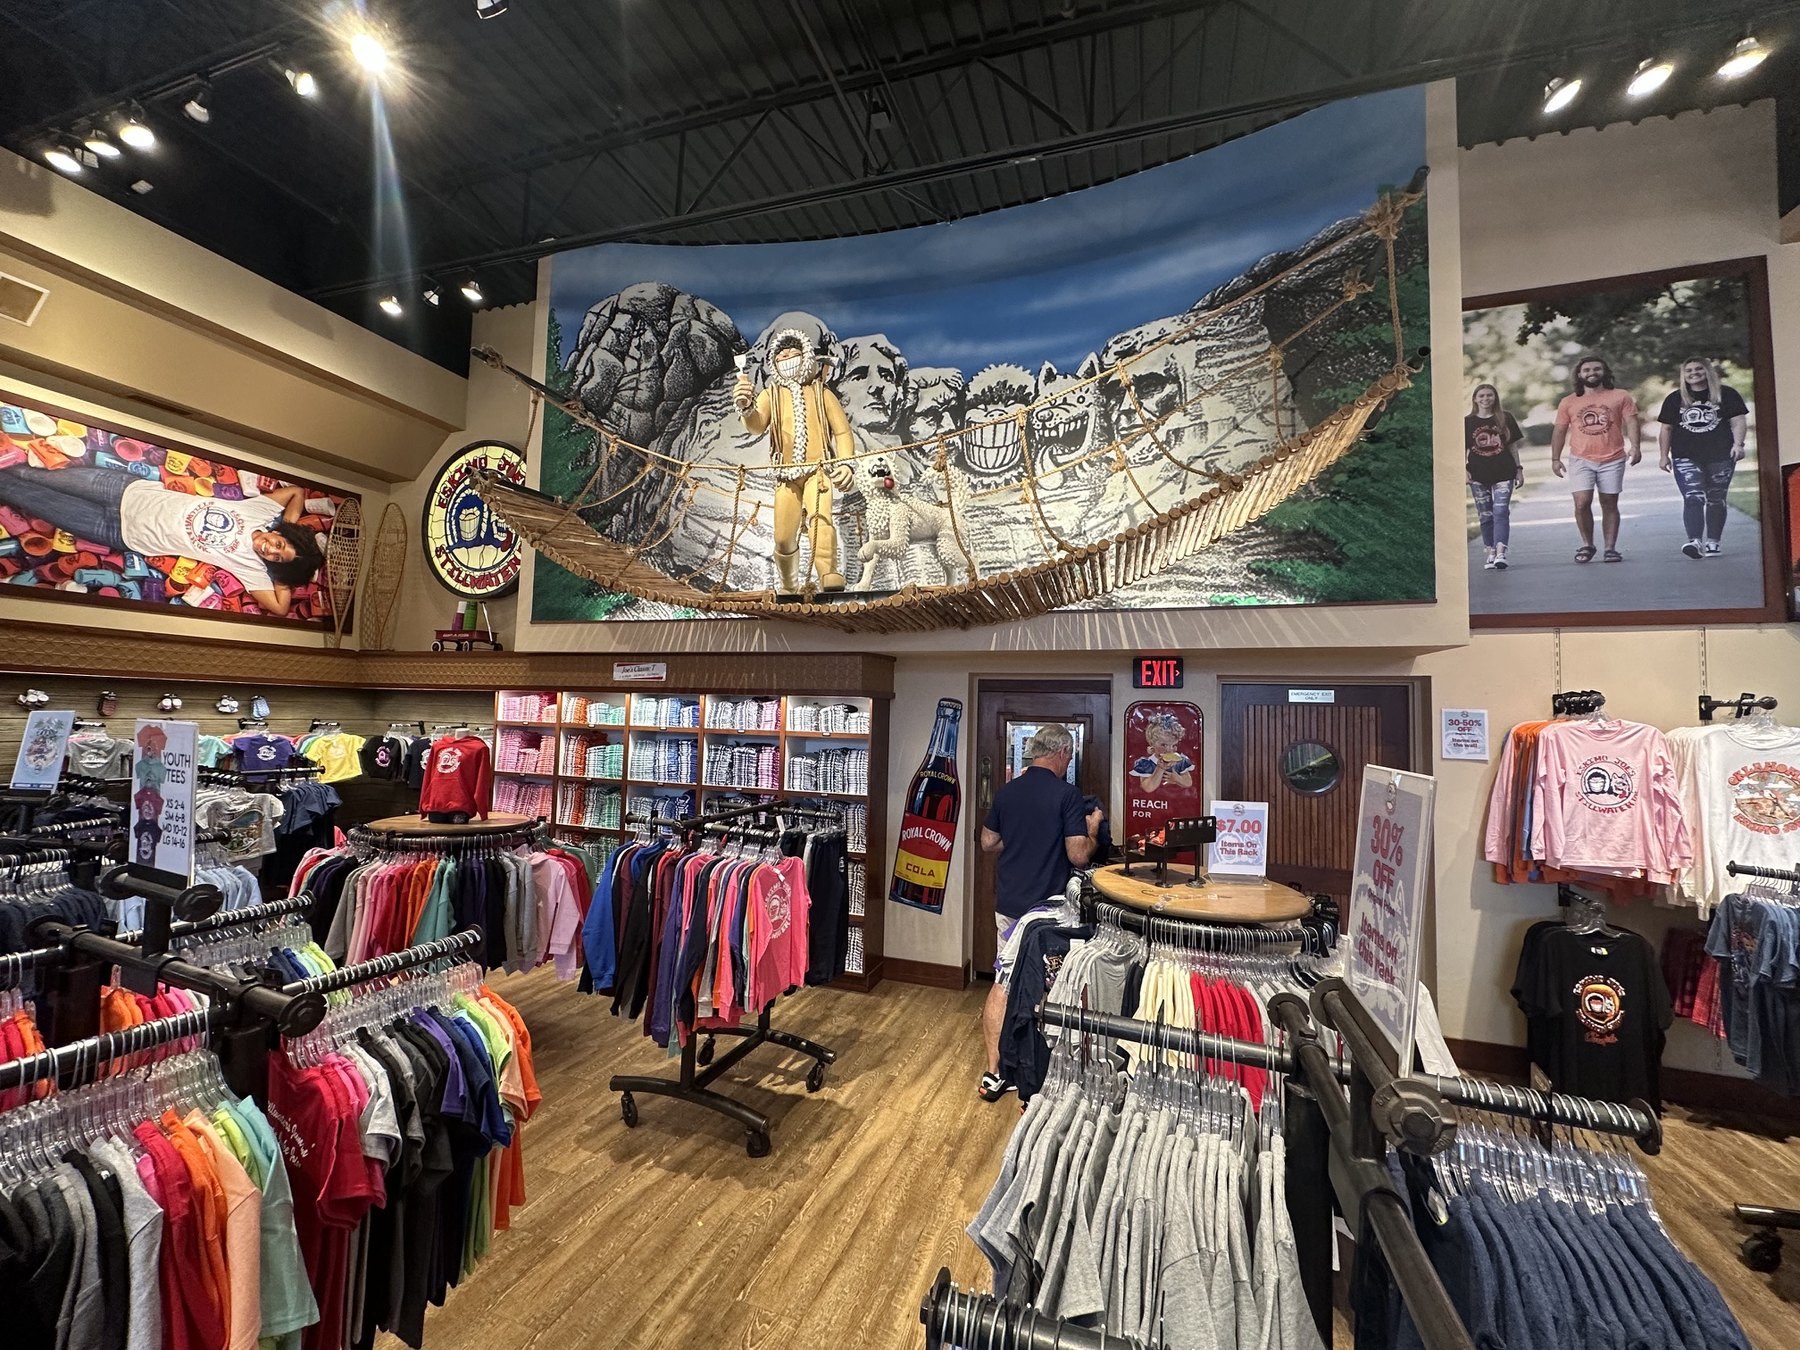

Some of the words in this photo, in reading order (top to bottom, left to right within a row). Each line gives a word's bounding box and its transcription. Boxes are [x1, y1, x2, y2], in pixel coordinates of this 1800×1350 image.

[437, 455, 488, 509] ESKIMO
[435, 544, 521, 589] STILLWATER
[1141, 660, 1177, 686] EXIT
[1448, 719, 1482, 727] 30-50%
[163, 751, 191, 769] YOUTH
[166, 768, 186, 784] TEES
[920, 770, 937, 778] ROYAL
[937, 772, 956, 785] CROWN
[1727, 761, 1800, 786] OKLAHOM
[166, 799, 174, 809] XS
[174, 800, 185, 811] 2-4
[1132, 799, 1168, 810] REACH
[165, 811, 174, 821] SM
[175, 812, 185, 824] 6-8
[1132, 810, 1152, 819] FOR
[162, 823, 172, 834] MD
[173, 824, 188, 837] 10-12
[1216, 819, 1262, 833] $7.00
[1782, 819, 1800, 833] JO
[162, 835, 171, 846] LG
[172, 837, 186, 849] 14-16
[902, 827, 924, 841] ROYAL
[924, 827, 952, 852] CROWN
[1221, 840, 1245, 848] Items
[1246, 841, 1257, 849] On
[1371, 814, 1404, 867] 30%
[1220, 847, 1236, 855] This
[1237, 848, 1258, 856] Rack
[905, 862, 936, 878] COLA
[1372, 859, 1395, 894] OFF
[1361, 912, 1385, 952] Items
[1386, 941, 1398, 964] on
[1358, 937, 1374, 968] this
[1375, 957, 1396, 985] rack
